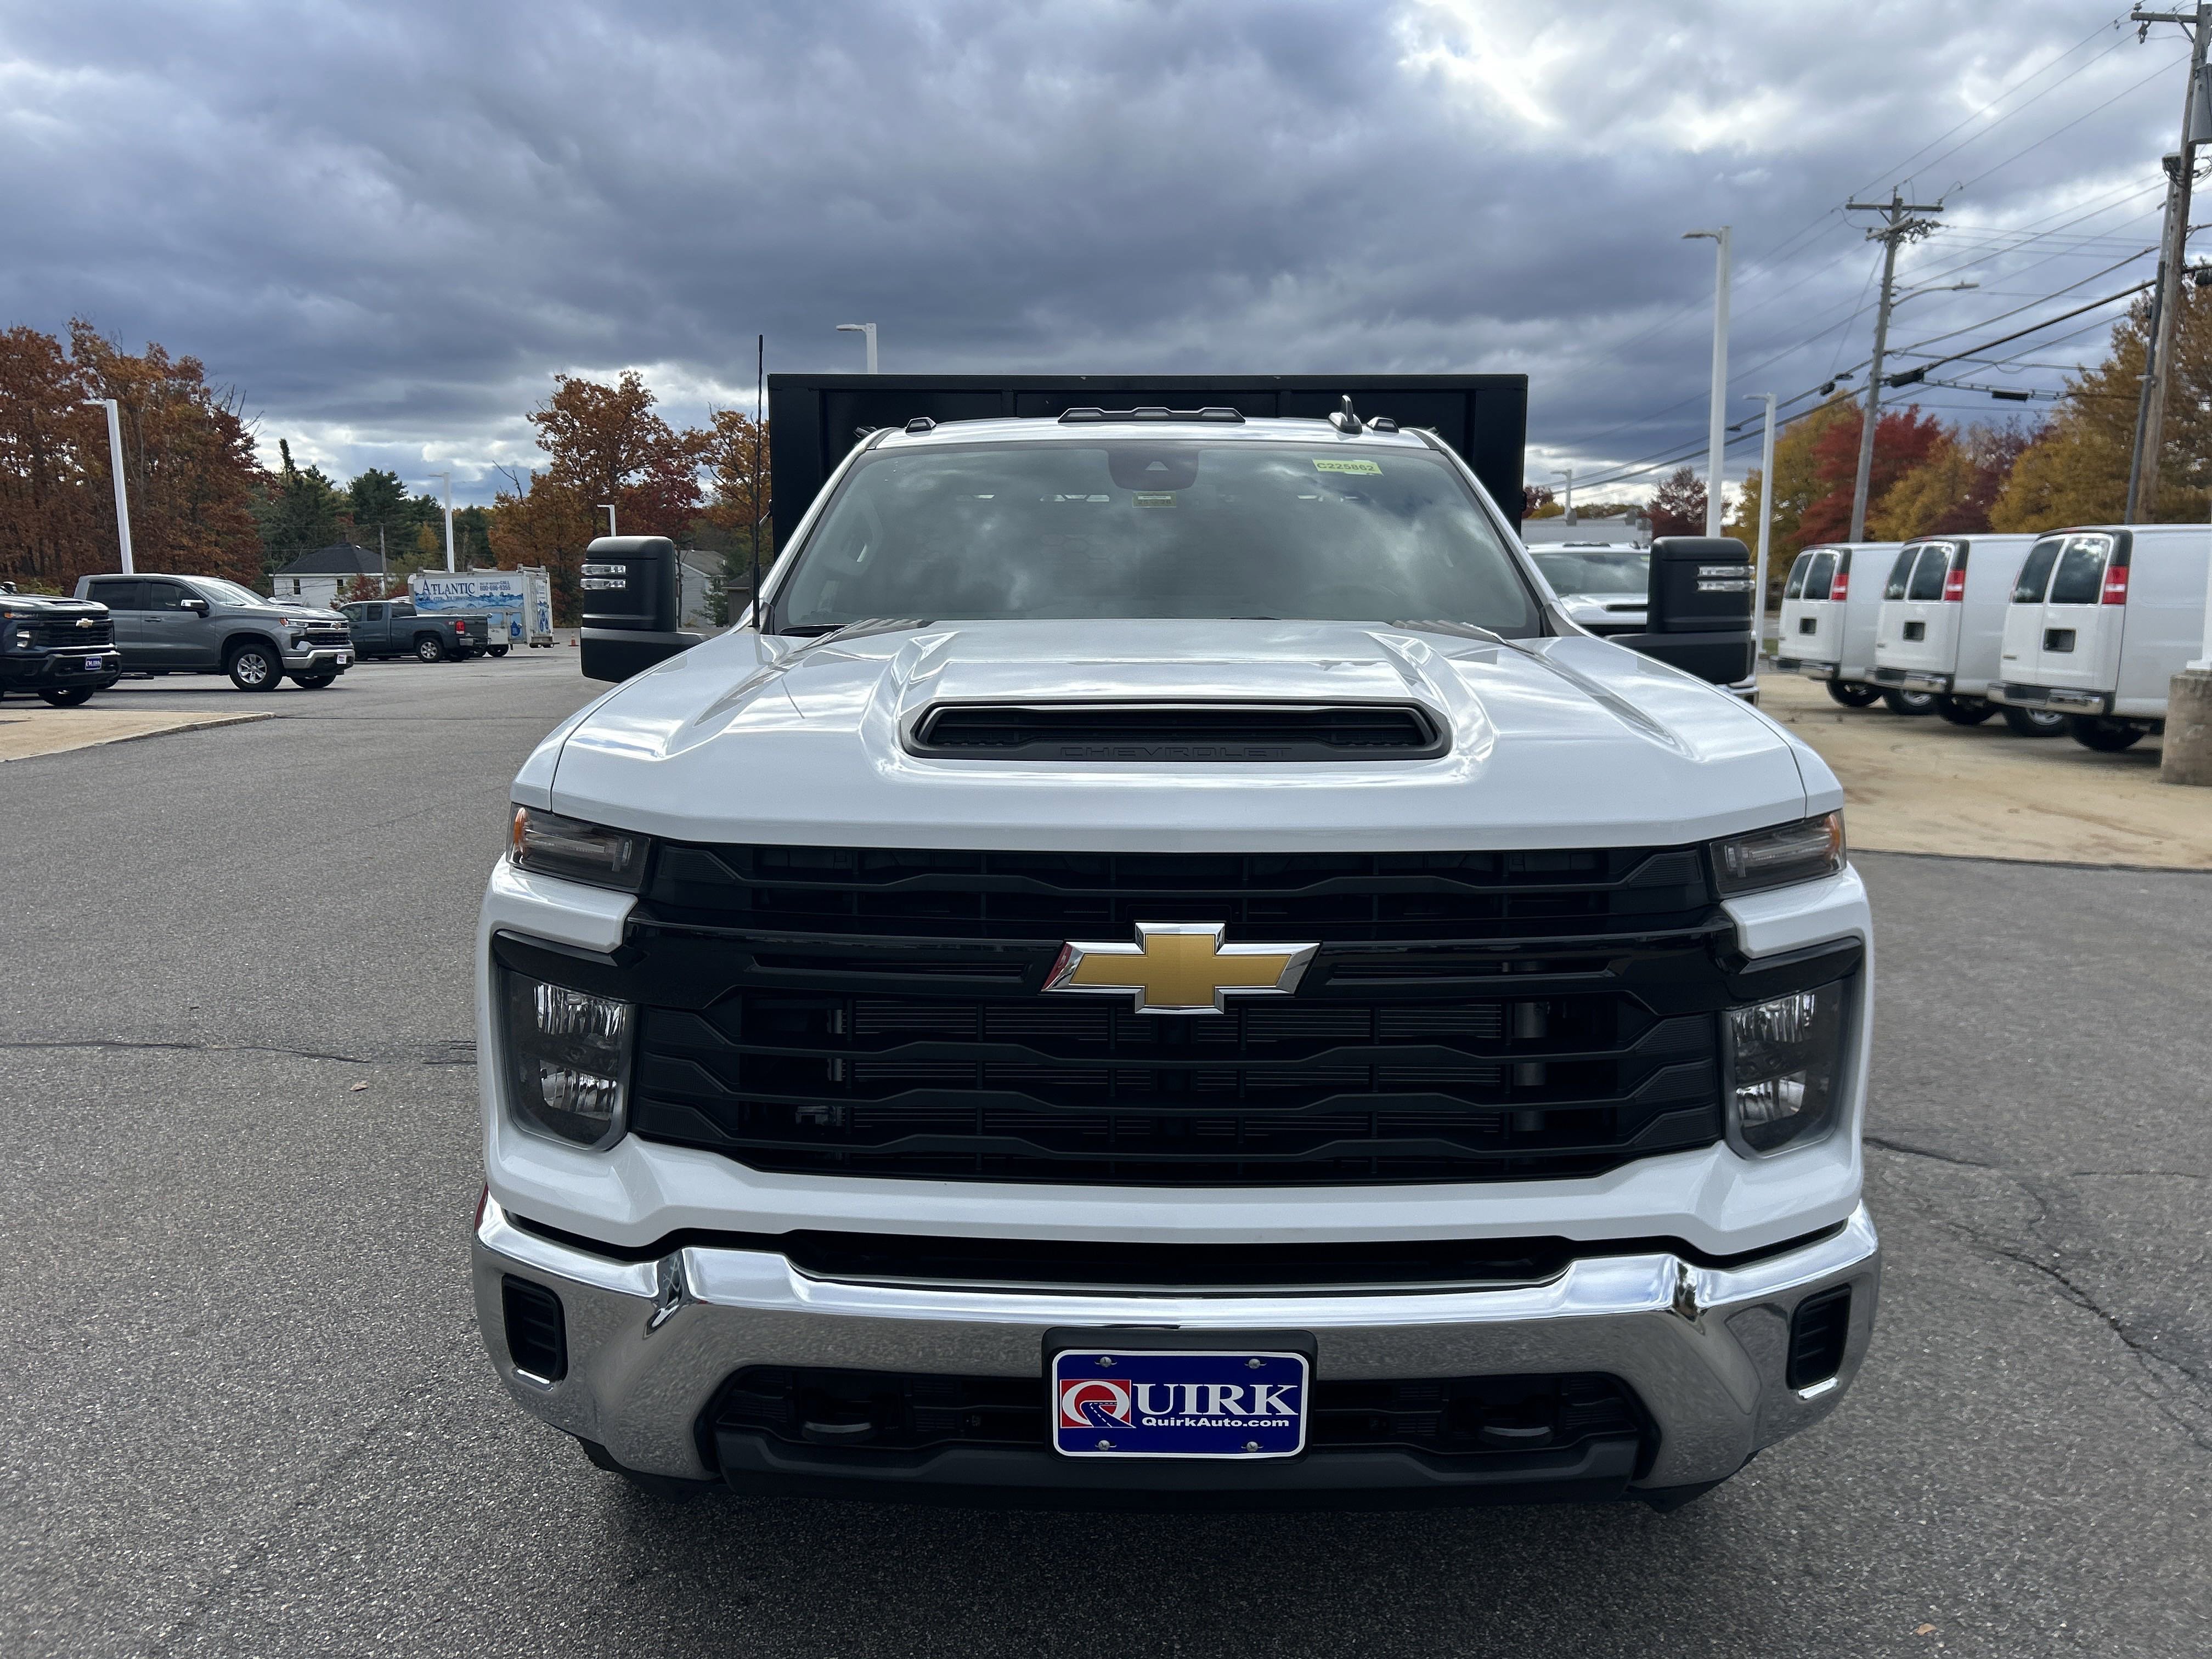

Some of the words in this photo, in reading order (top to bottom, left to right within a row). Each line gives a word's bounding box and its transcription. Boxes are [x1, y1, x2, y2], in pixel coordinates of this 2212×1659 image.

[1316, 462, 1375, 471] C225862
[422, 579, 475, 597] ATLANTIC
[1060, 747, 1293, 757] CHEVROLET
[1062, 1379, 1299, 1429] QUIRK
[1142, 1417, 1289, 1427] QuirkAuto.com
